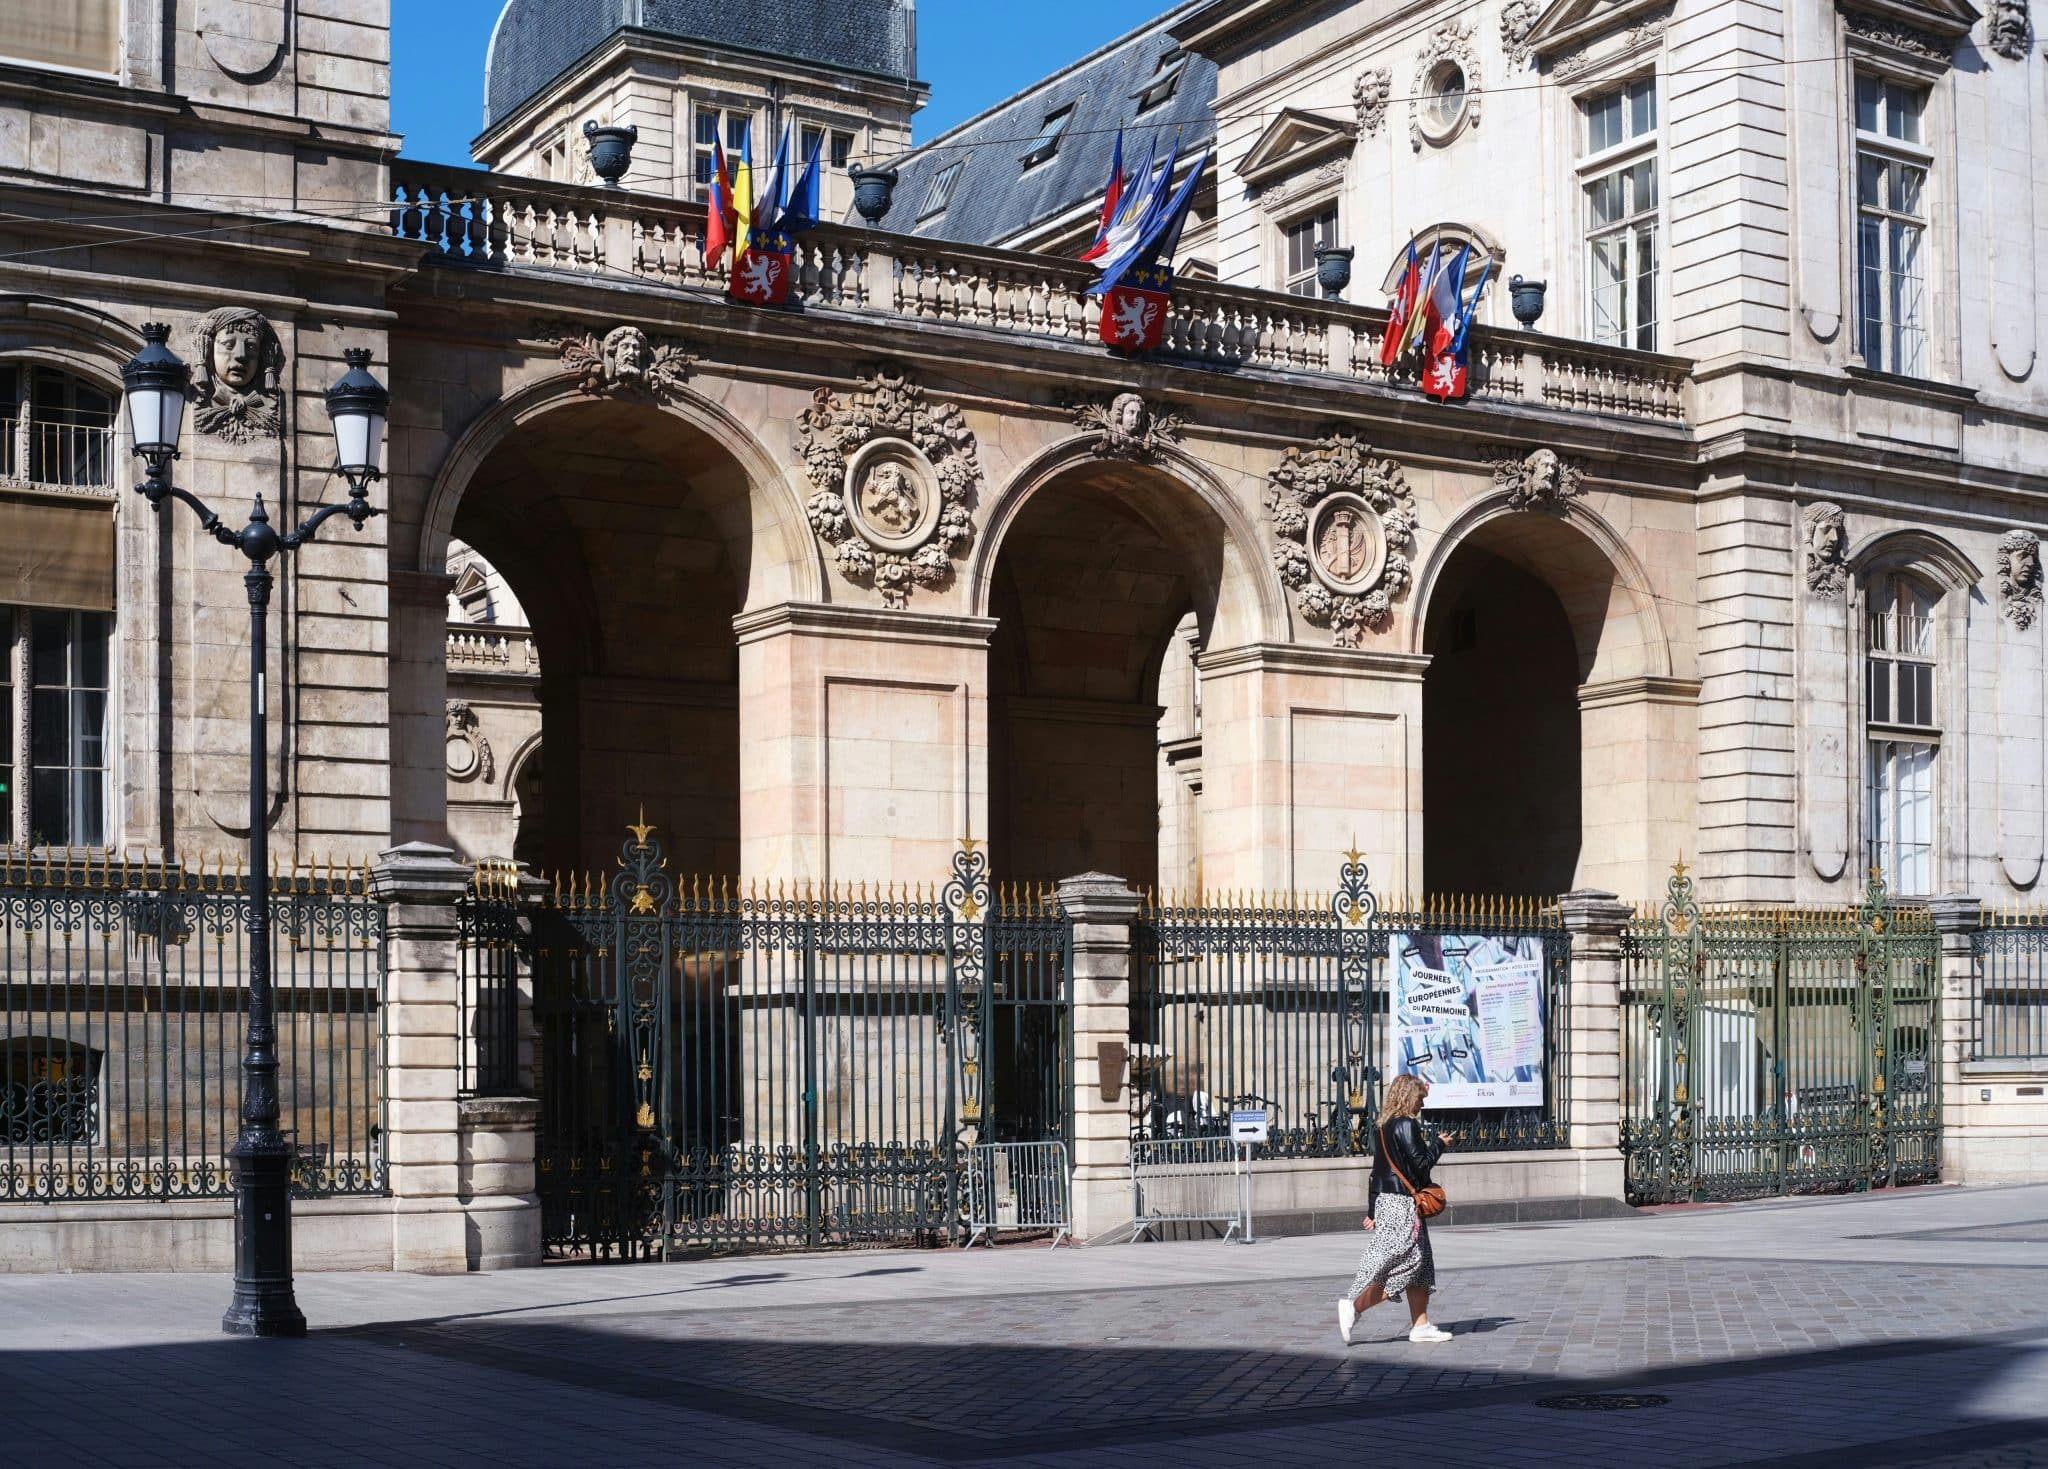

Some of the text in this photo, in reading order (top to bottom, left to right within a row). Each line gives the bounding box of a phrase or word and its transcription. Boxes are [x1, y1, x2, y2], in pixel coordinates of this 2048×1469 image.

[1412, 970, 1452, 984] JOURNÉES
[1408, 986, 1461, 1004] EUROPÉENNES
[1422, 1005, 1467, 1016] PATRIMOINE
